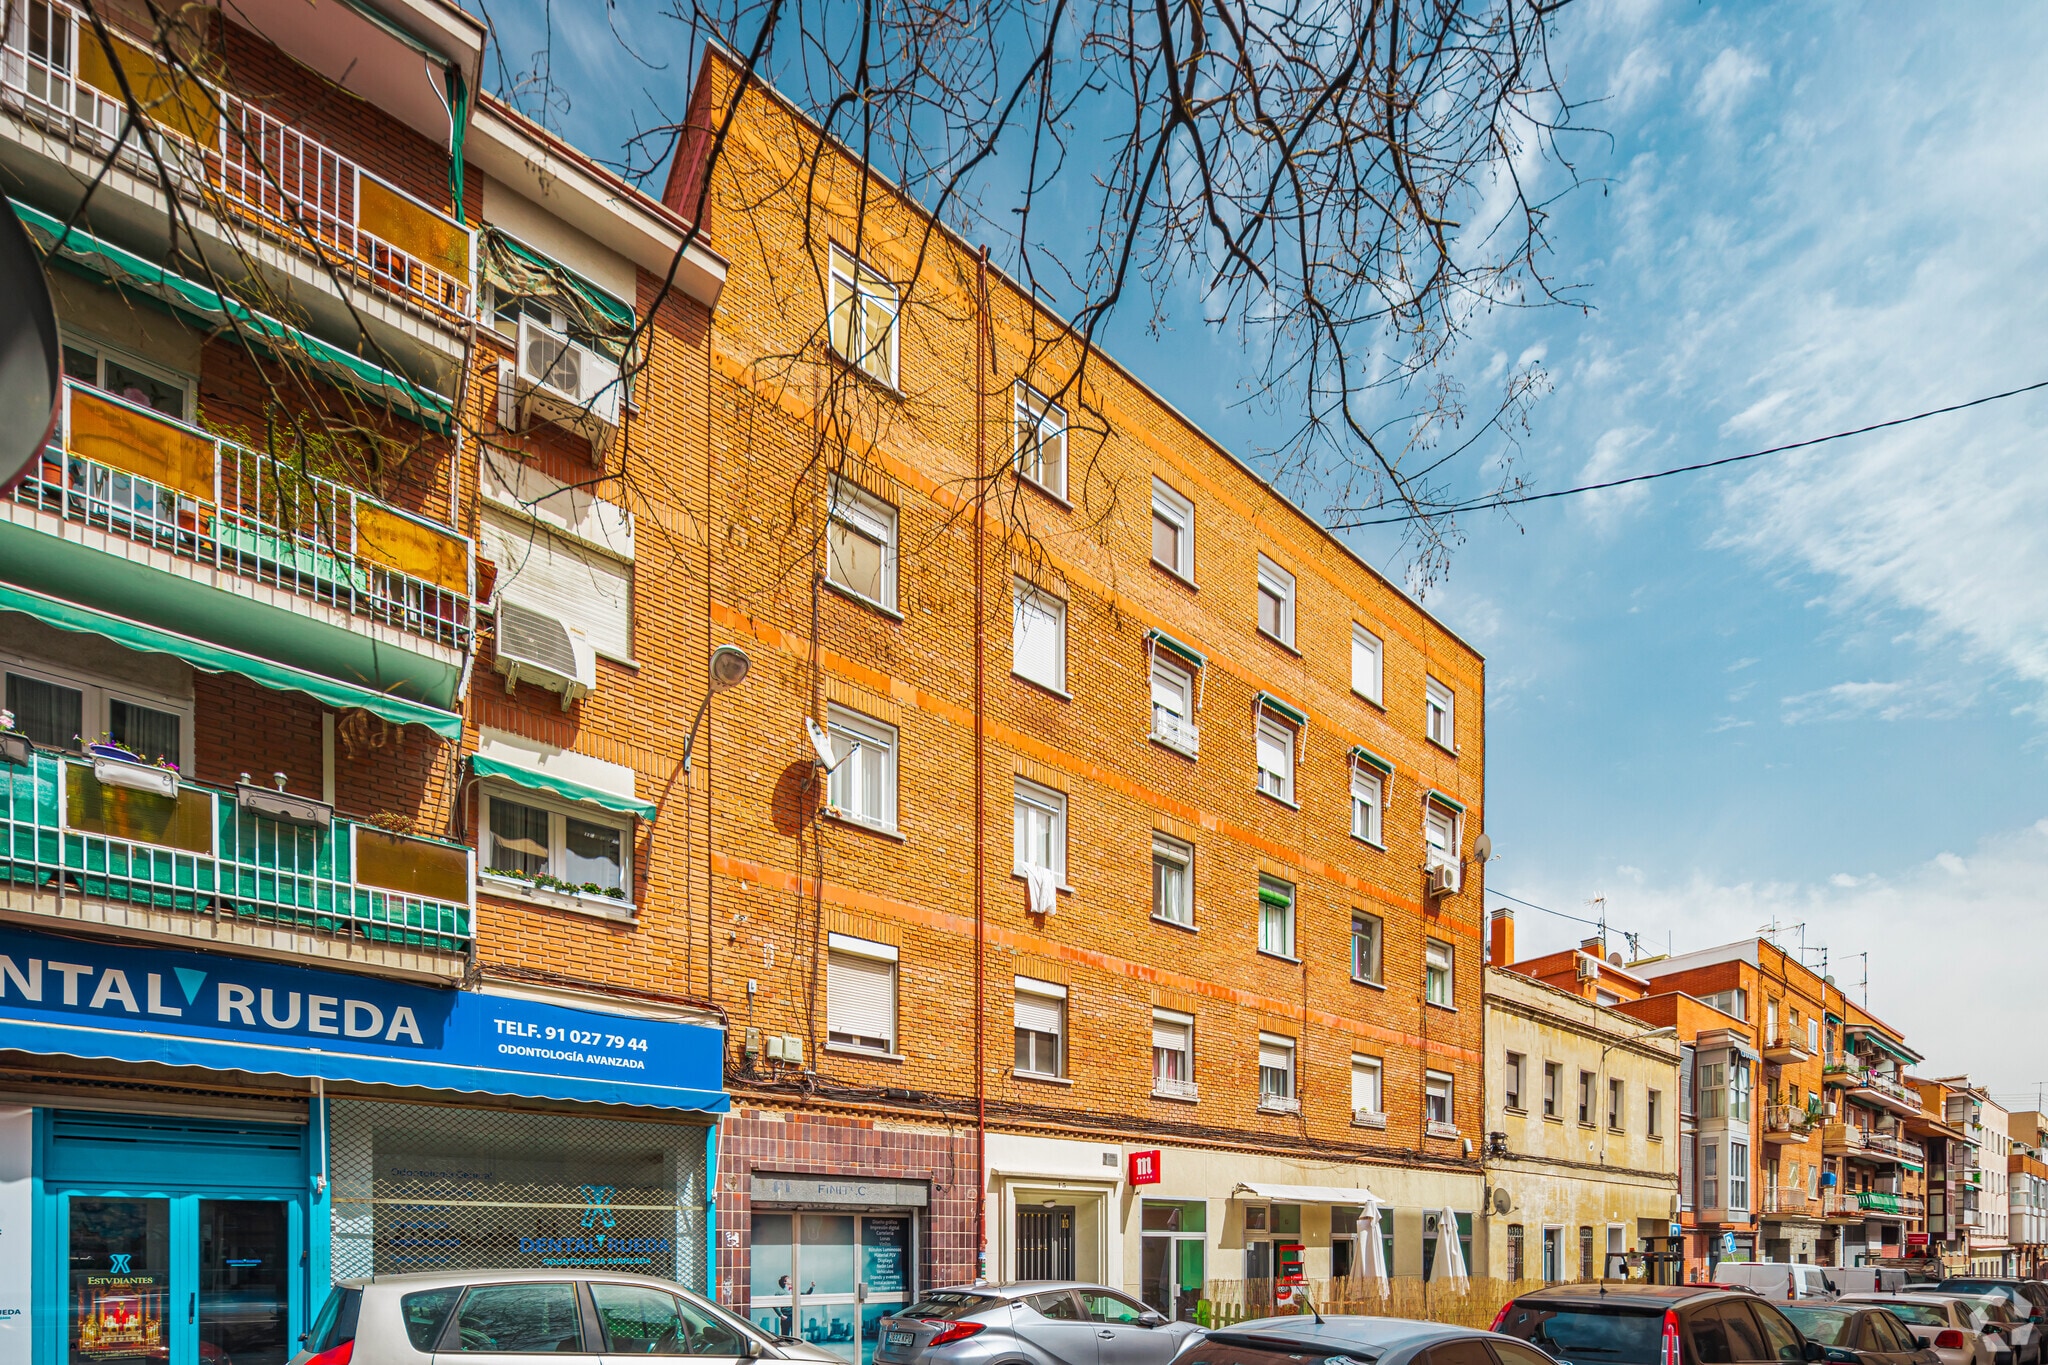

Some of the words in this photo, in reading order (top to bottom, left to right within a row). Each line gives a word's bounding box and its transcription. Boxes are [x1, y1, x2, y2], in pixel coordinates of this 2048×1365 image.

[218, 983, 424, 1045] RUEDA
[493, 1019, 541, 1039] TELF.
[545, 1026, 565, 1042] 91
[569, 1030, 602, 1046] 027
[605, 1034, 625, 1049] 79
[627, 1038, 648, 1052] 44
[498, 1044, 584, 1062] ODONTOLOGÍA
[586, 1054, 645, 1070] AVANZADA
[519, 1236, 597, 1253] DENTAL
[607, 1237, 670, 1253] RUEDA
